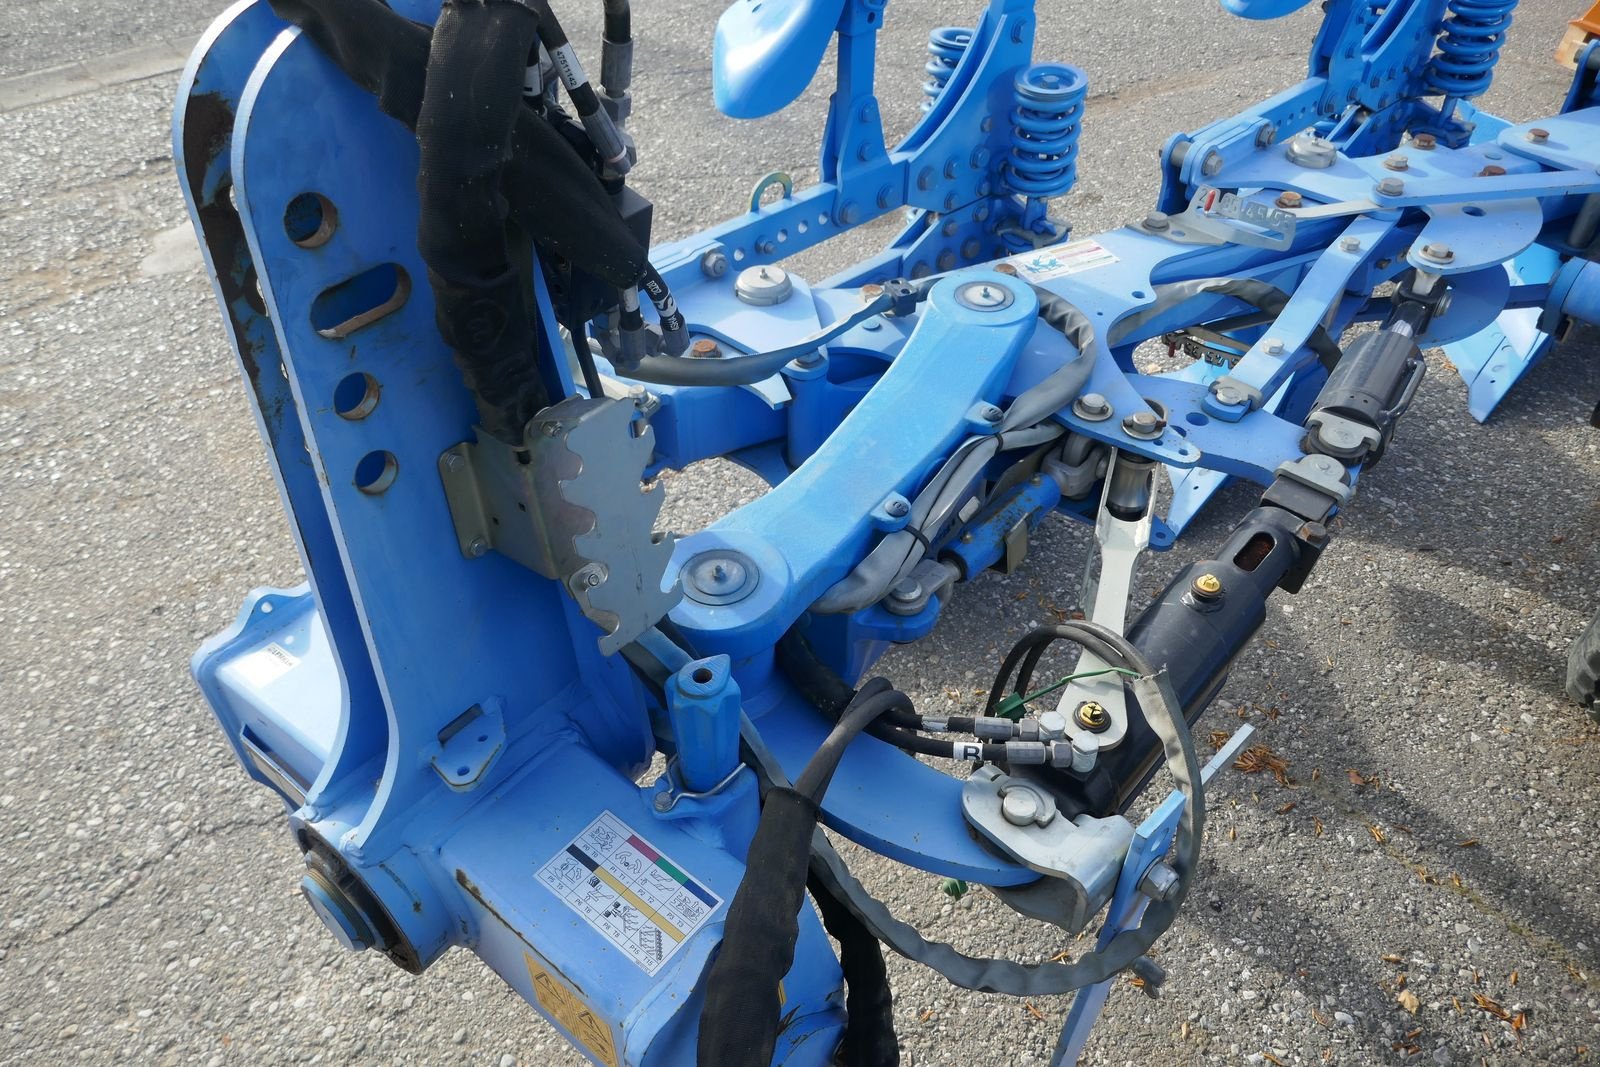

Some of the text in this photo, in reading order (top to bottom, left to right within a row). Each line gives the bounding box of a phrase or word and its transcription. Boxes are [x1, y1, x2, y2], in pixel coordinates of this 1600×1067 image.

[557, 51, 577, 86] 47511142
[637, 888, 645, 896] P2
[666, 912, 684, 928] P3 T3
[629, 944, 639, 955] P15
[643, 956, 654, 966] T15
